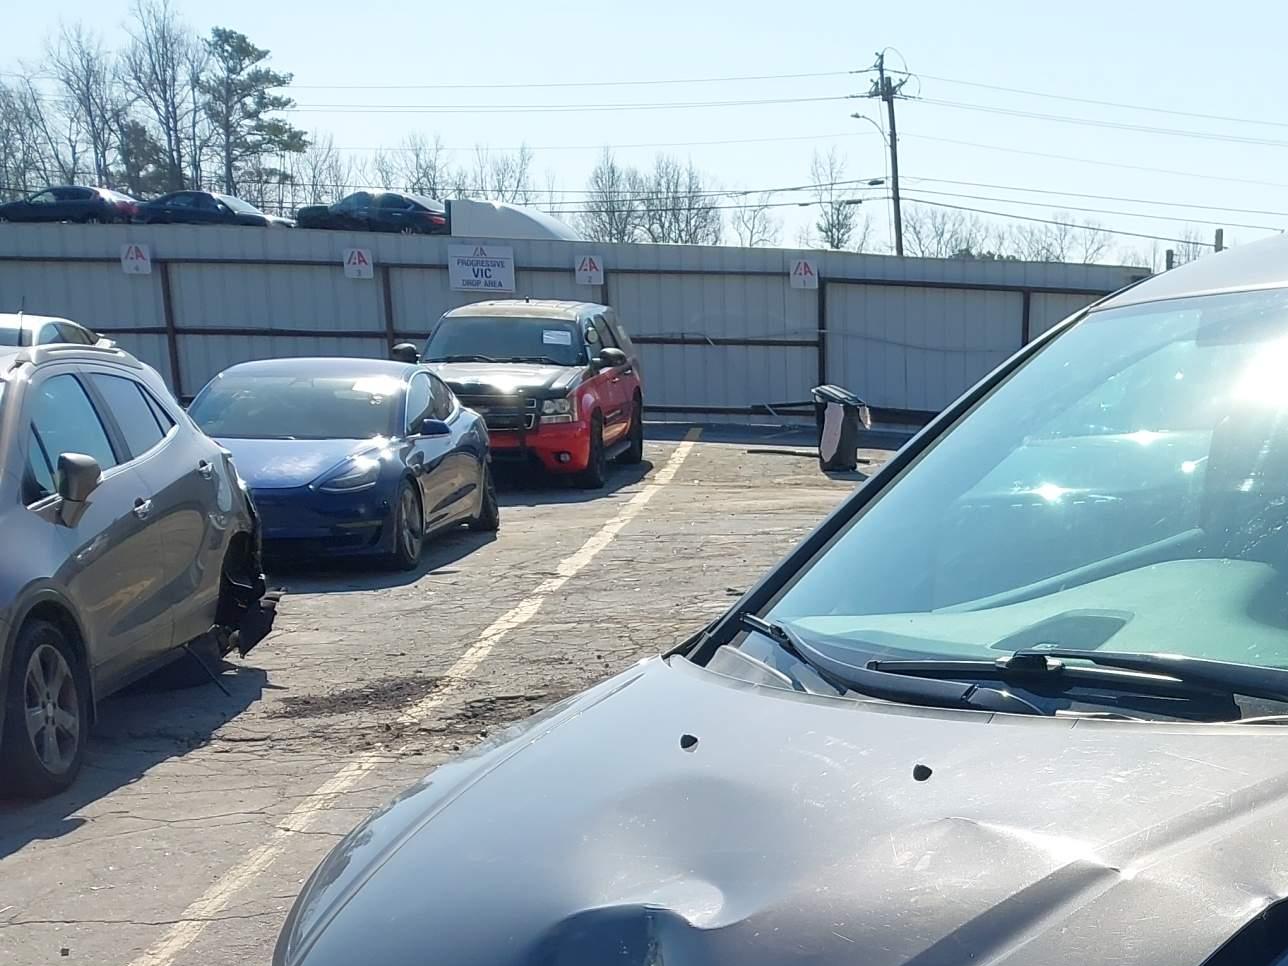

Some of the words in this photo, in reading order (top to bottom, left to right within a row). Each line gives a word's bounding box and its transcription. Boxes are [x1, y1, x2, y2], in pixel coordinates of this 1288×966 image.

[456, 258, 505, 269] PROGRESSIVE
[472, 267, 492, 279] VIC
[462, 279, 481, 288] DROP
